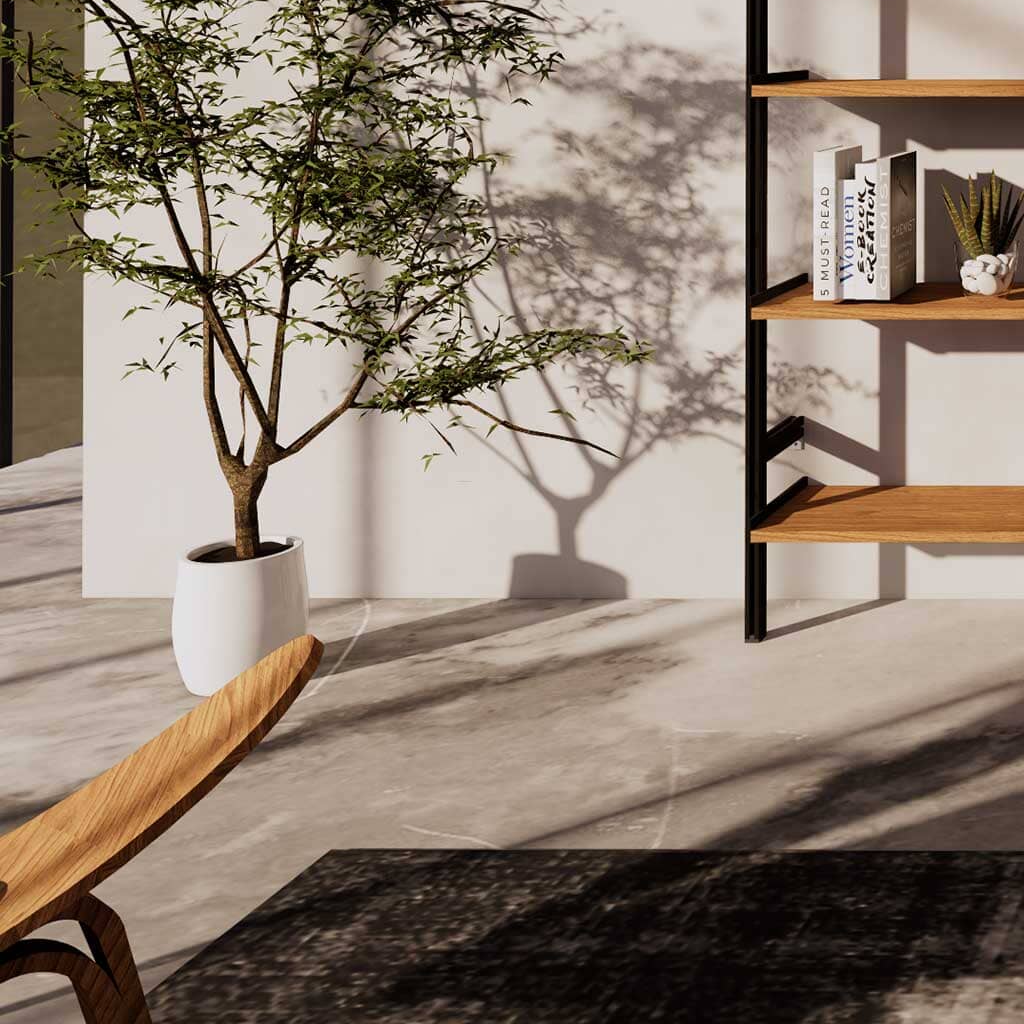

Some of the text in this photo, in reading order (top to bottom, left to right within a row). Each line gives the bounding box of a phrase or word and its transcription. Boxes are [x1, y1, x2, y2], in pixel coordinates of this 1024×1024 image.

[821, 186, 830, 280] MUST-READ
[839, 196, 854, 283] Women
[857, 187, 866, 273] E-BOOK
[864, 176, 877, 284] CREATION
[880, 167, 888, 290] CHEMIST
